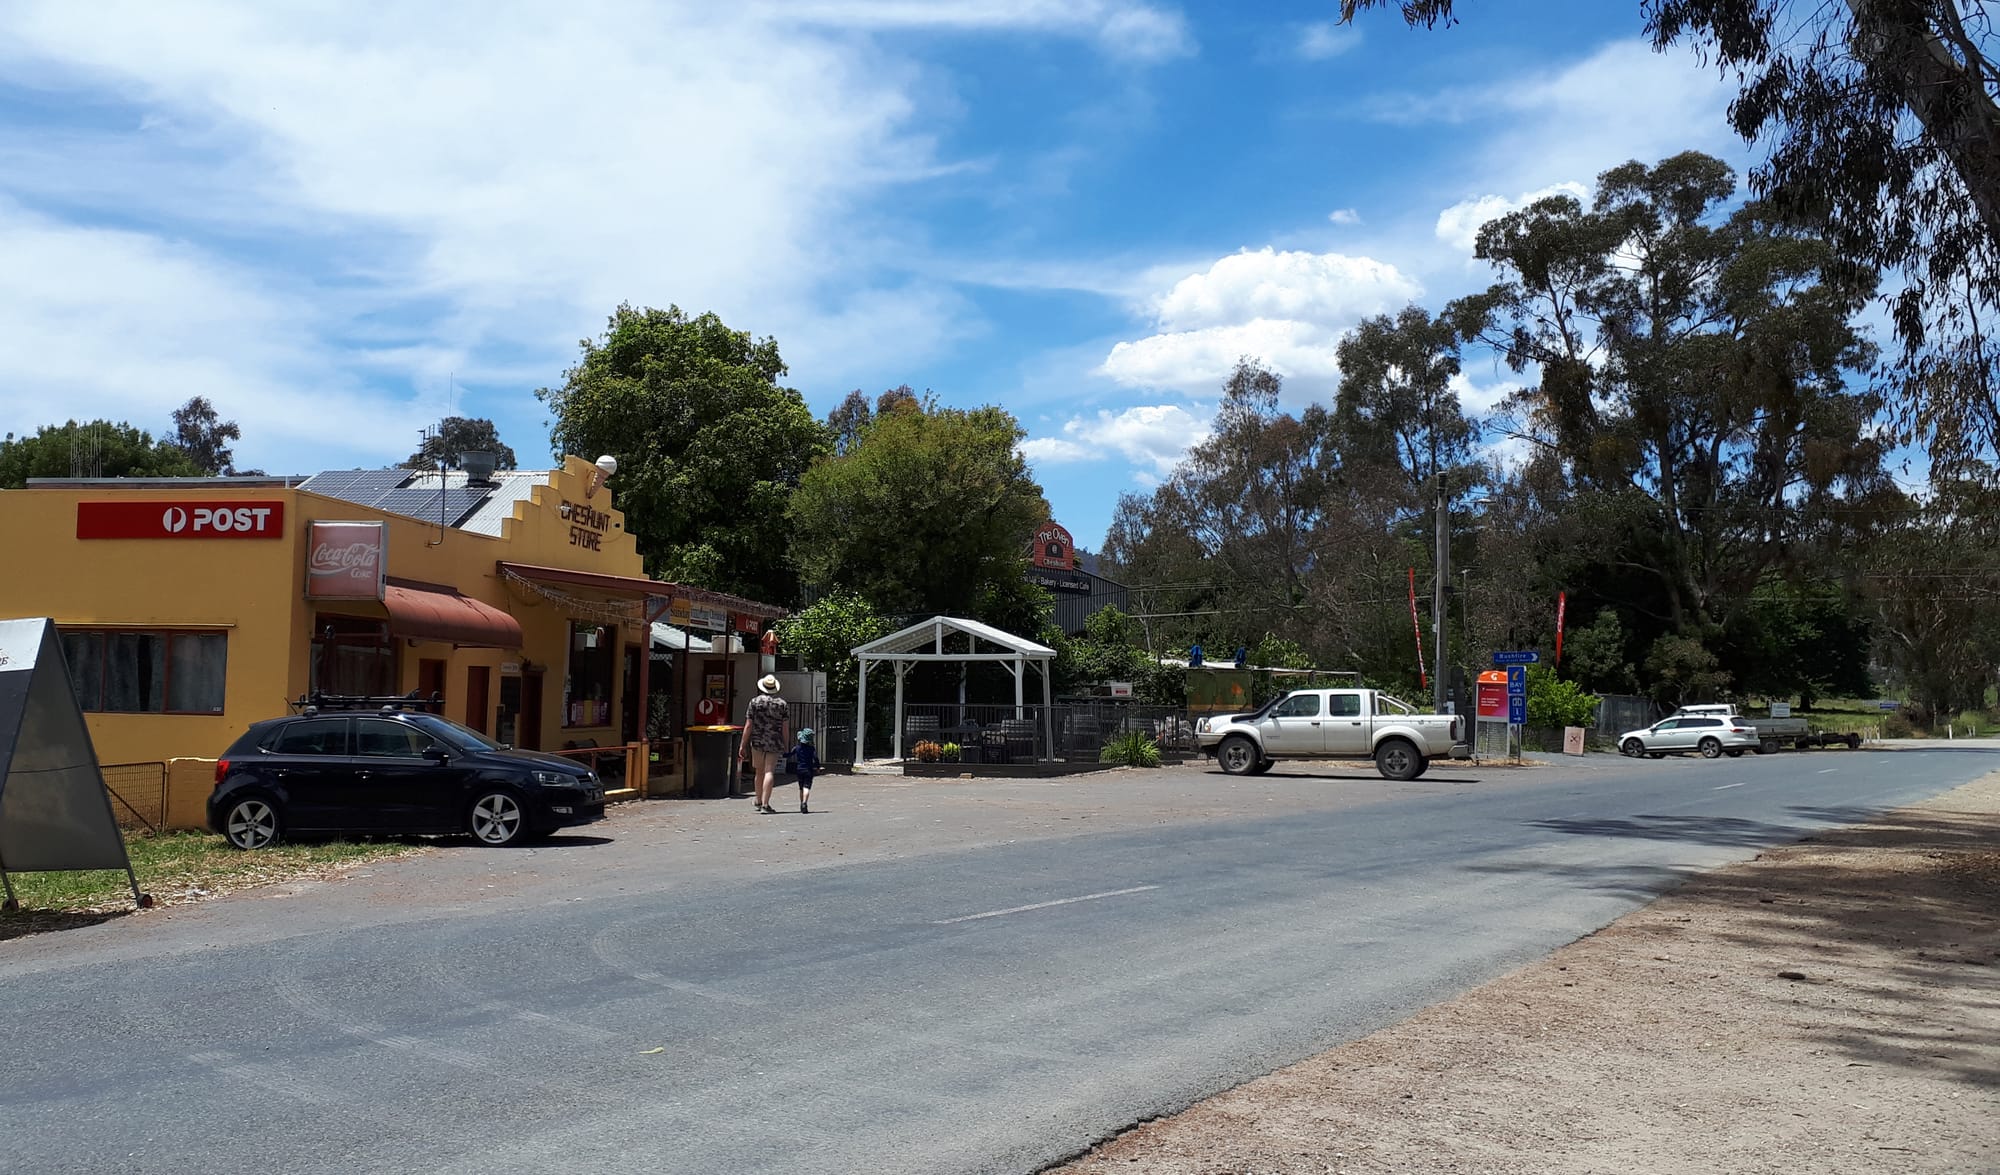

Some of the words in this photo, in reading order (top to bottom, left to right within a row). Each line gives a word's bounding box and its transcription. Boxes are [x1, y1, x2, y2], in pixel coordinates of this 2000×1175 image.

[193, 508, 270, 531] POST
[569, 525, 602, 552] STORE
[1039, 531, 1052, 544] The
[1053, 528, 1069, 547] Oven
[312, 543, 380, 567] Coca-Cola
[1040, 576, 1057, 588] Bakery
